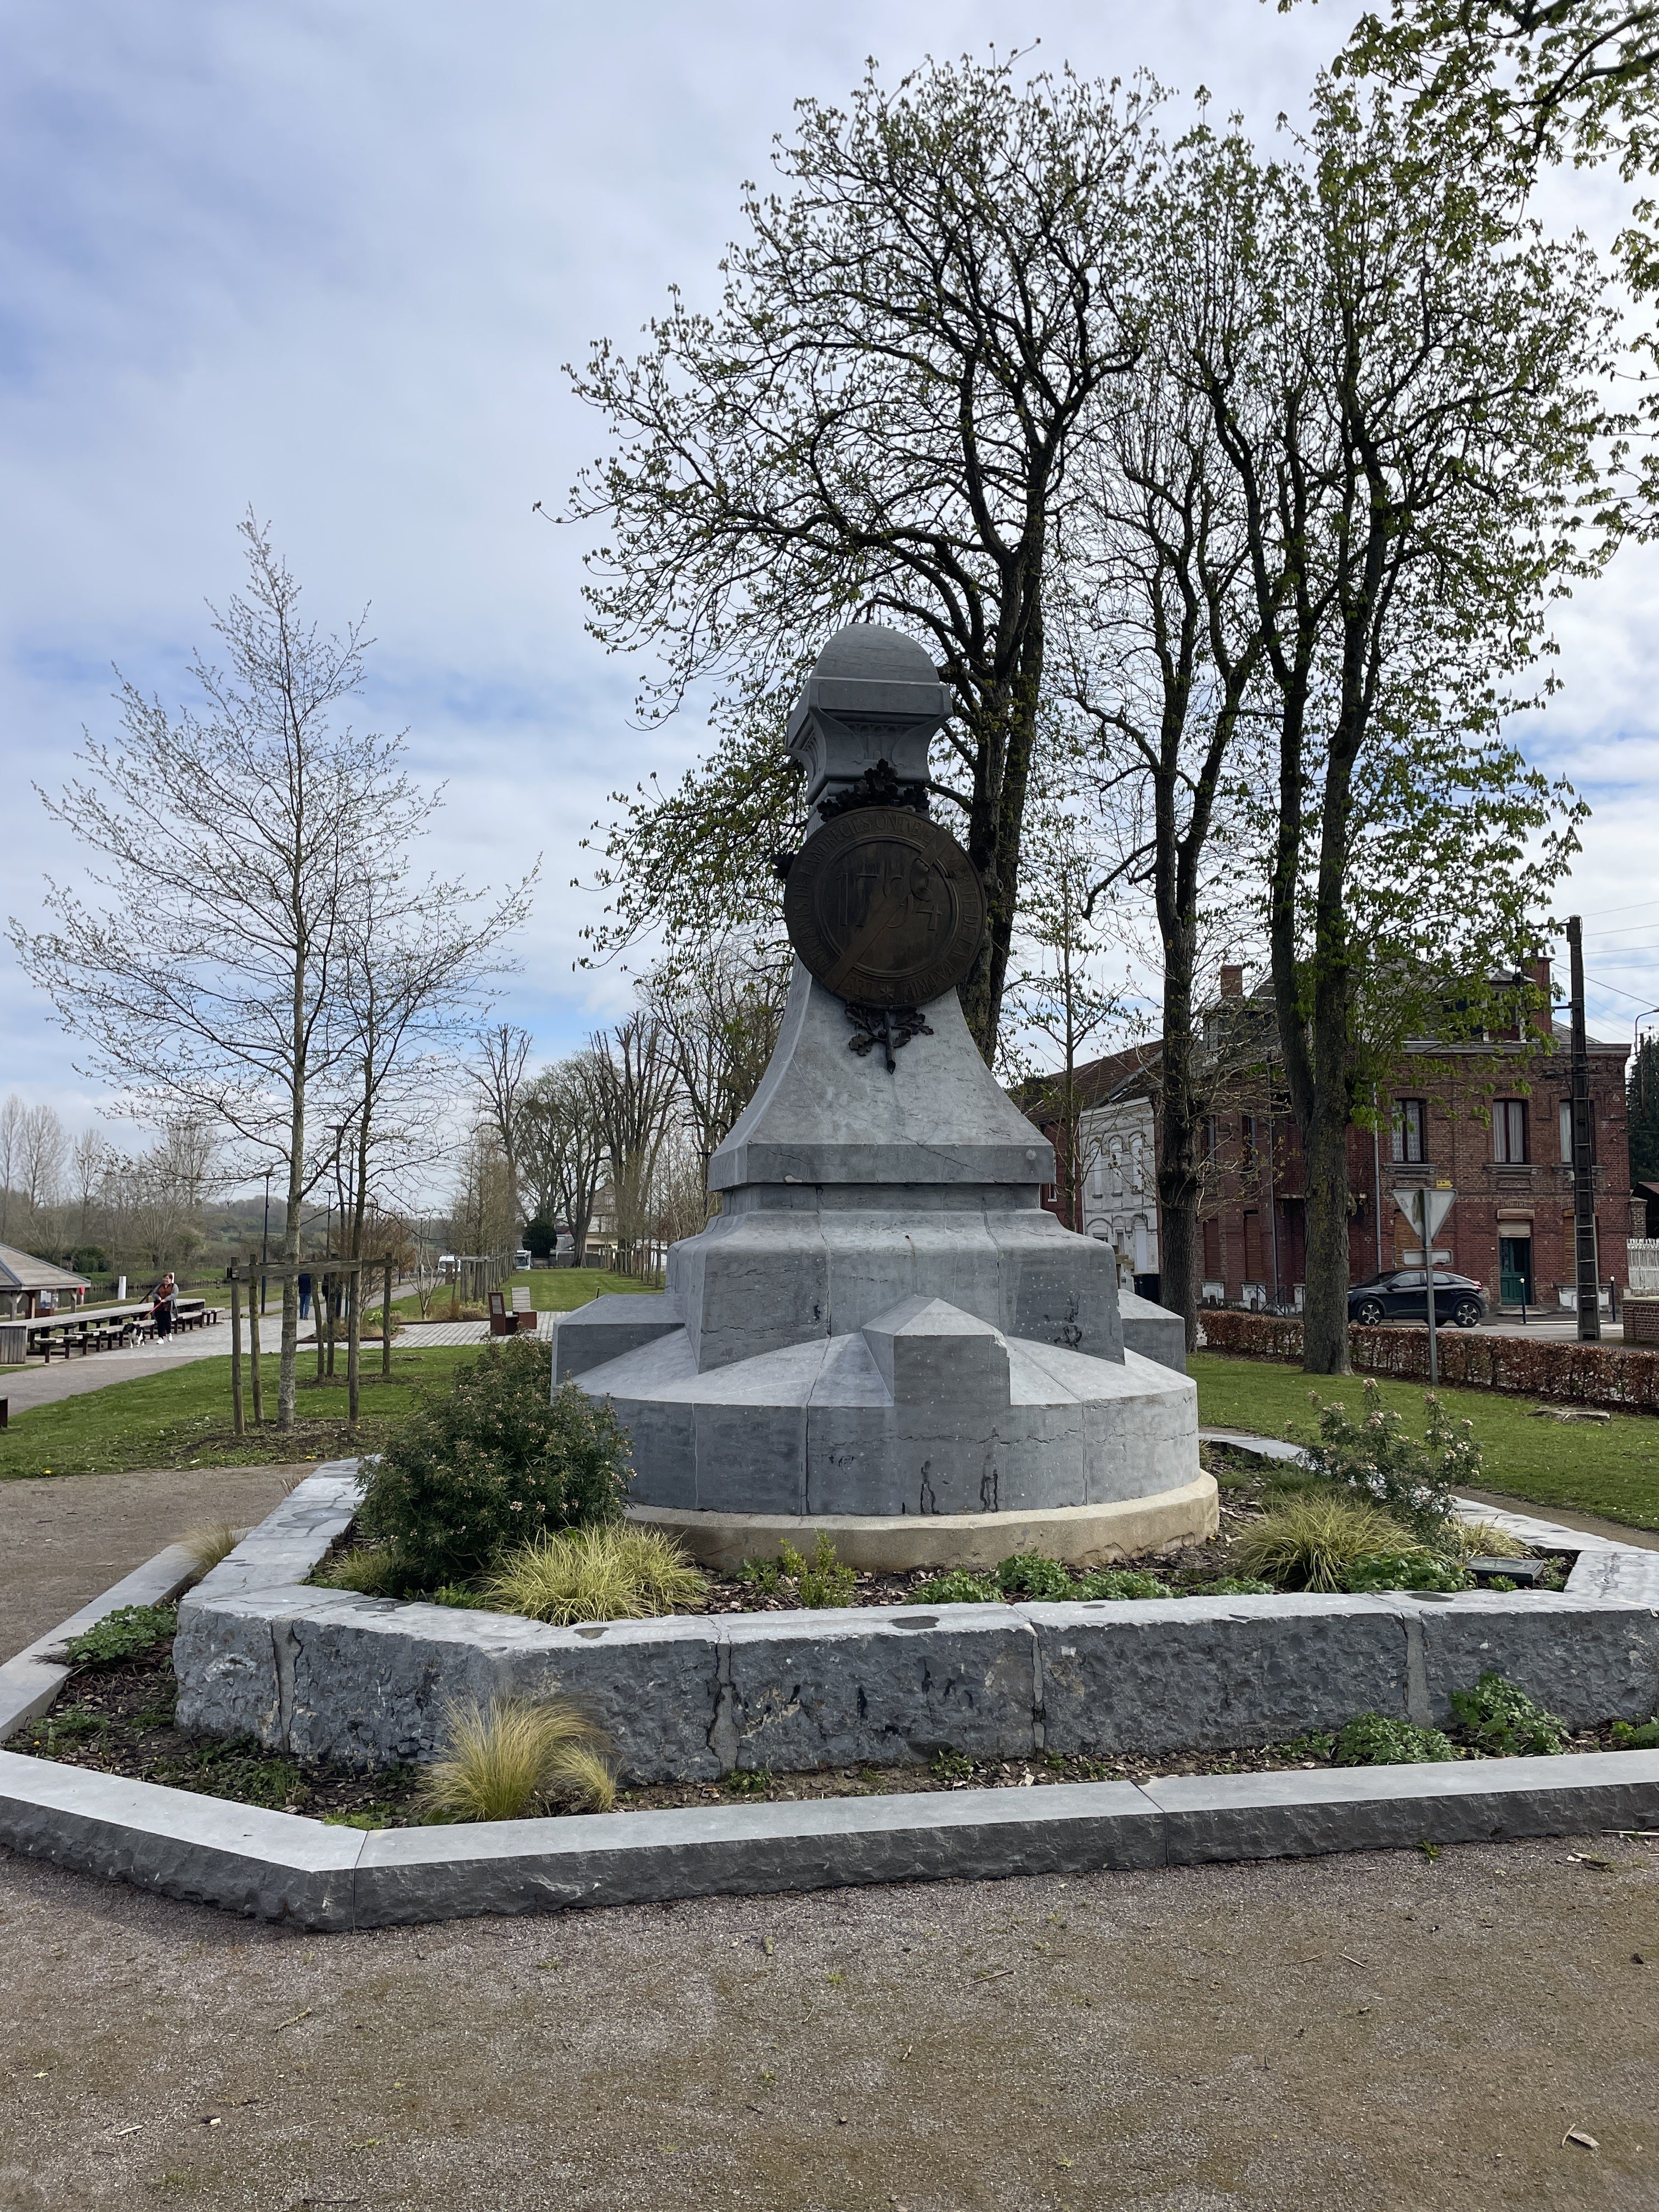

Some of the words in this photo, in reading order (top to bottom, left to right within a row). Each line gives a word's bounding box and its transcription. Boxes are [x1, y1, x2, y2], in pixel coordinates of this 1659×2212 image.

[874, 813, 907, 832] ONT
[910, 820, 937, 843] BIE
[960, 913, 980, 935] DE
[951, 935, 974, 961] LA
